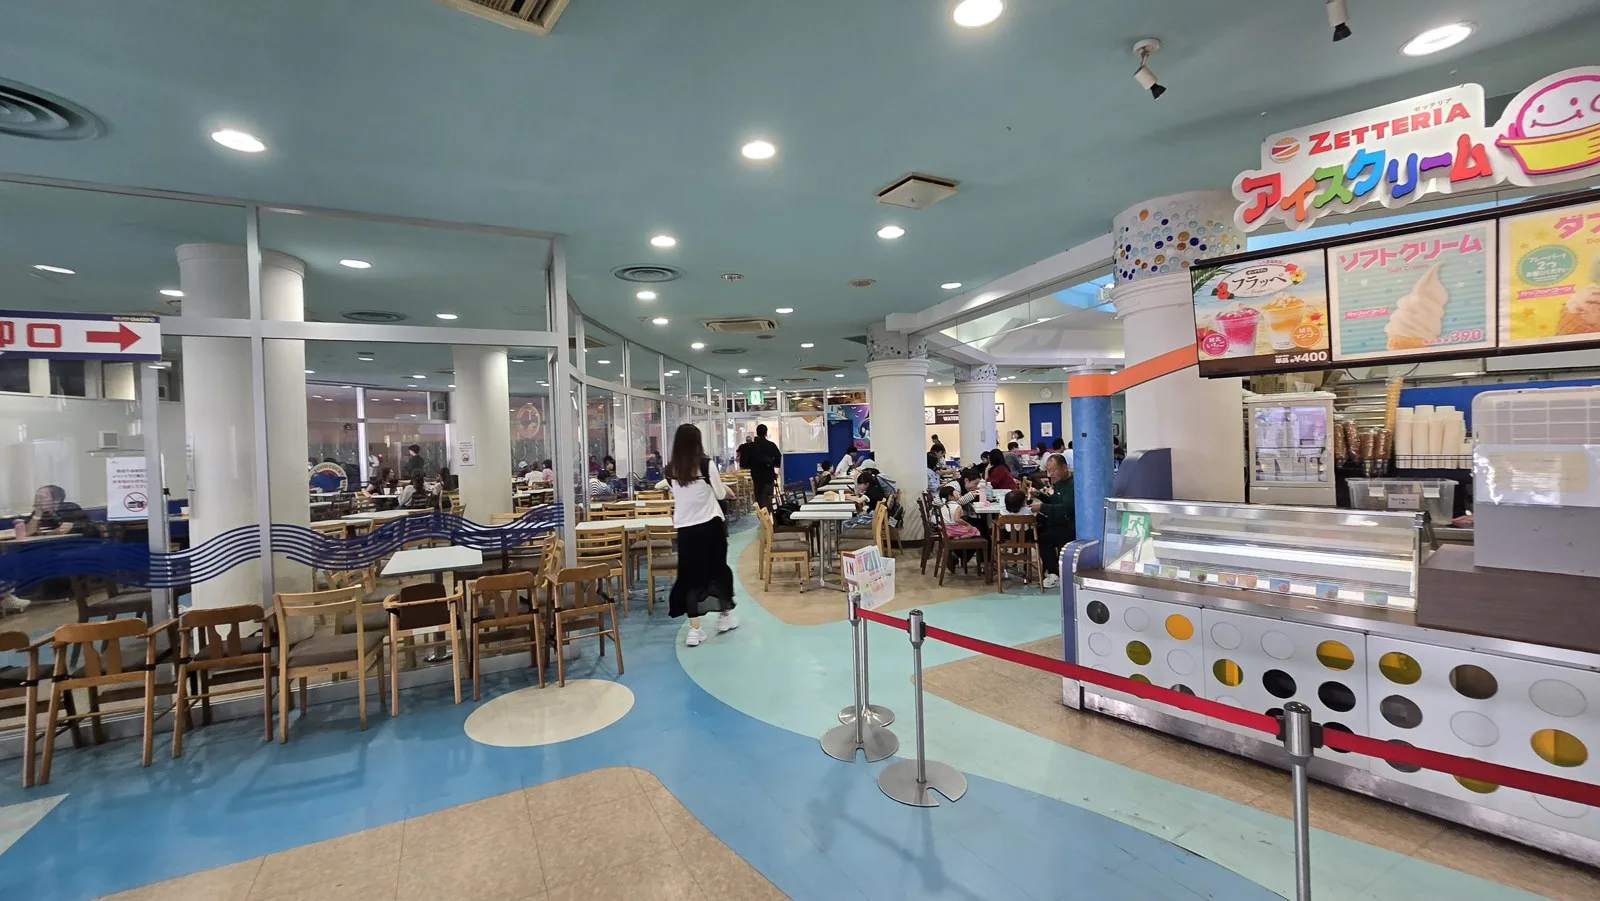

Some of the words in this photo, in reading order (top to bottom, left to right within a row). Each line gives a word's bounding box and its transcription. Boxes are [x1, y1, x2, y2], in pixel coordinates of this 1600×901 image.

[1414, 98, 1452, 111] ゼッテリア
[1308, 102, 1471, 155] ZETTERIA
[1241, 133, 1493, 223] アイスクリーム
[1339, 233, 1483, 272] ソフトクリーム
[1537, 261, 1557, 270] 2つ
[1232, 273, 1287, 291] フラッペ
